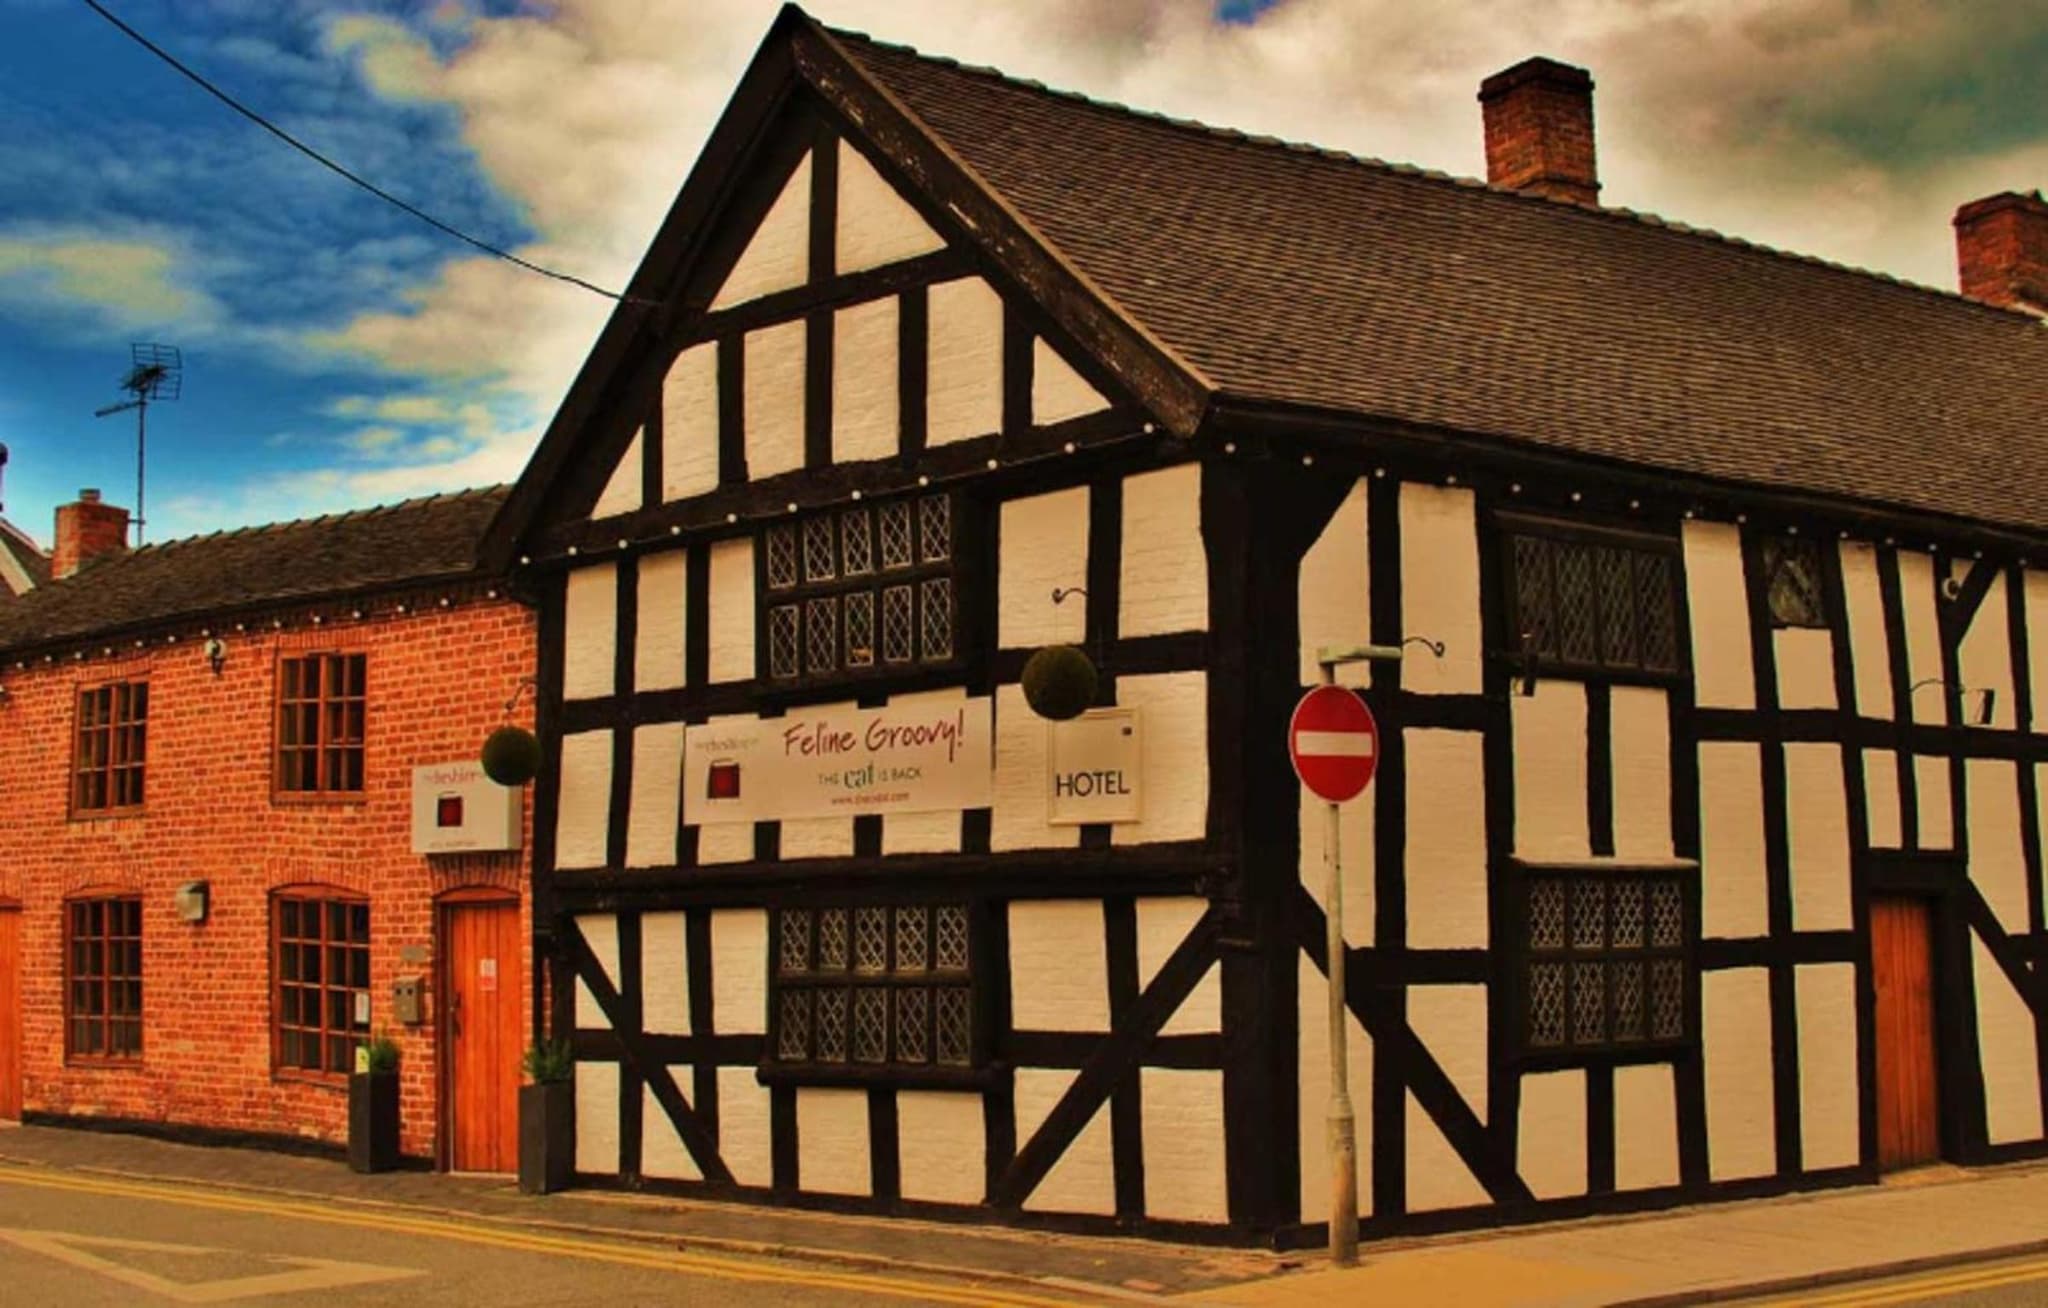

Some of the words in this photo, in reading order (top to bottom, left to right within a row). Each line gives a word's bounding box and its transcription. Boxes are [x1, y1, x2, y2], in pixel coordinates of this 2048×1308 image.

[784, 722, 856, 756] Feline
[865, 707, 965, 763] Groovy!
[819, 773, 839, 785] THE
[844, 762, 874, 789] cat
[879, 769, 888, 781] IS
[892, 767, 922, 781] BACK
[1056, 769, 1131, 797] HOTEL
